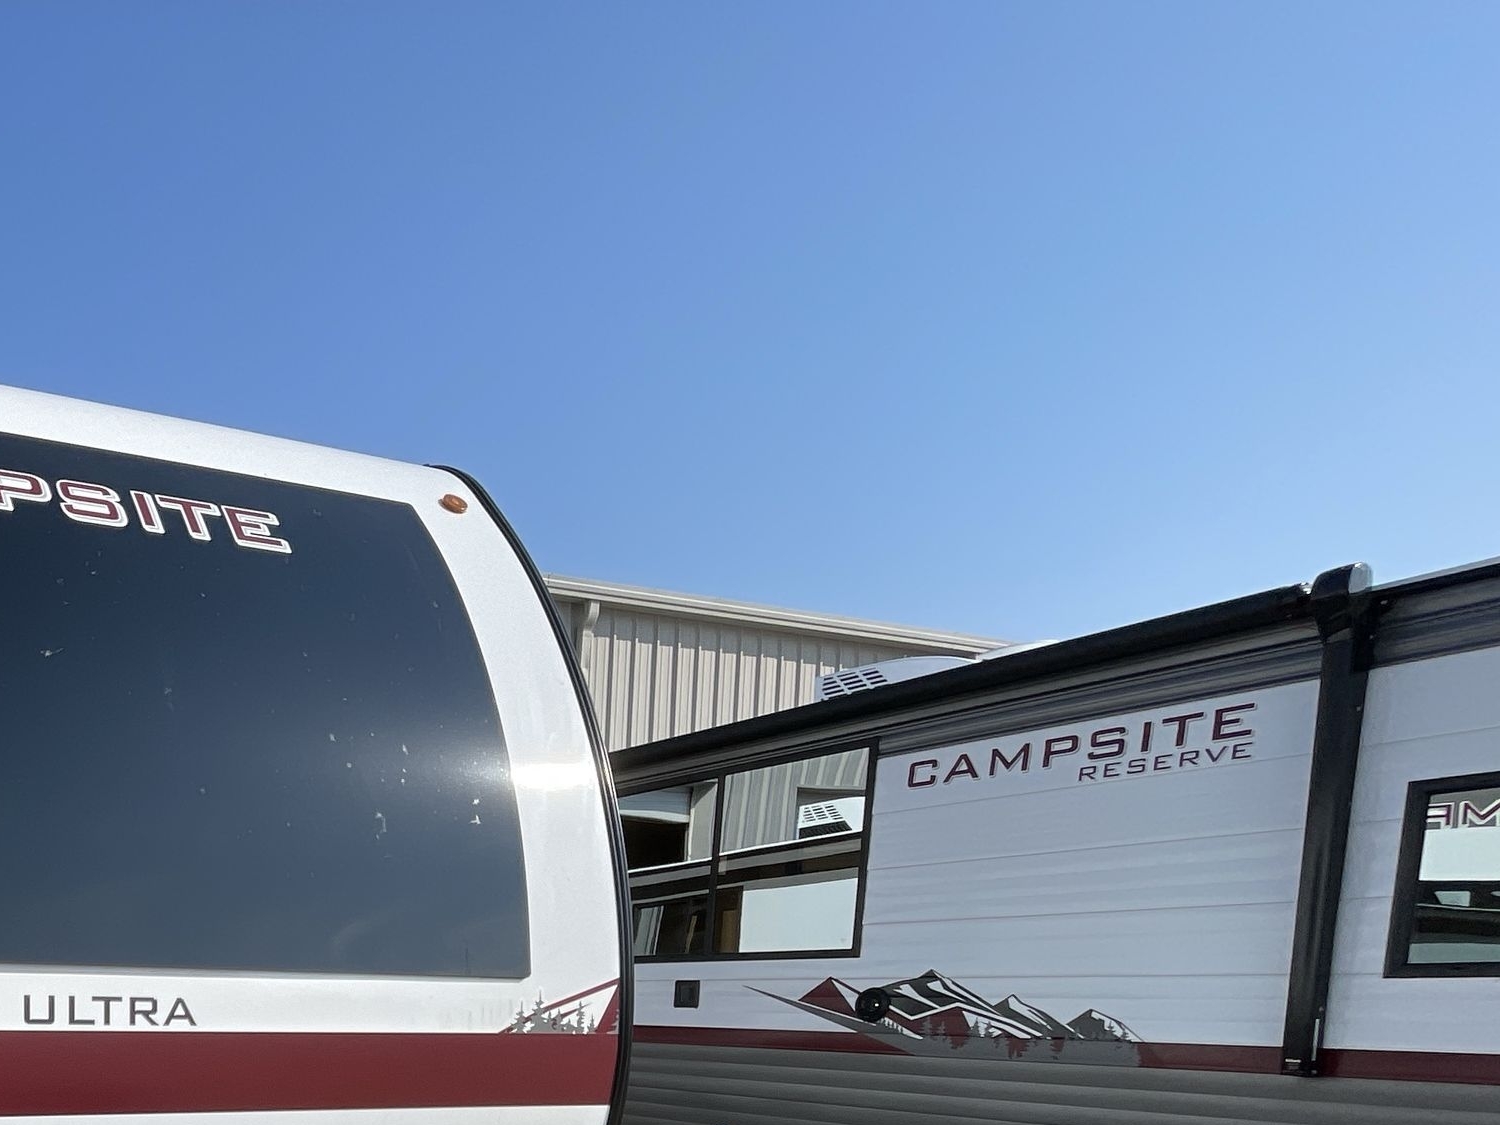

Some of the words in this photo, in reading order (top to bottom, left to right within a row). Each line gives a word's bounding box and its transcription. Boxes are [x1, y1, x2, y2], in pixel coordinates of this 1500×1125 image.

[907, 702, 1256, 789] CAMPSITE
[1078, 742, 1254, 782] RESERVE
[23, 994, 198, 1027] ULTRA
